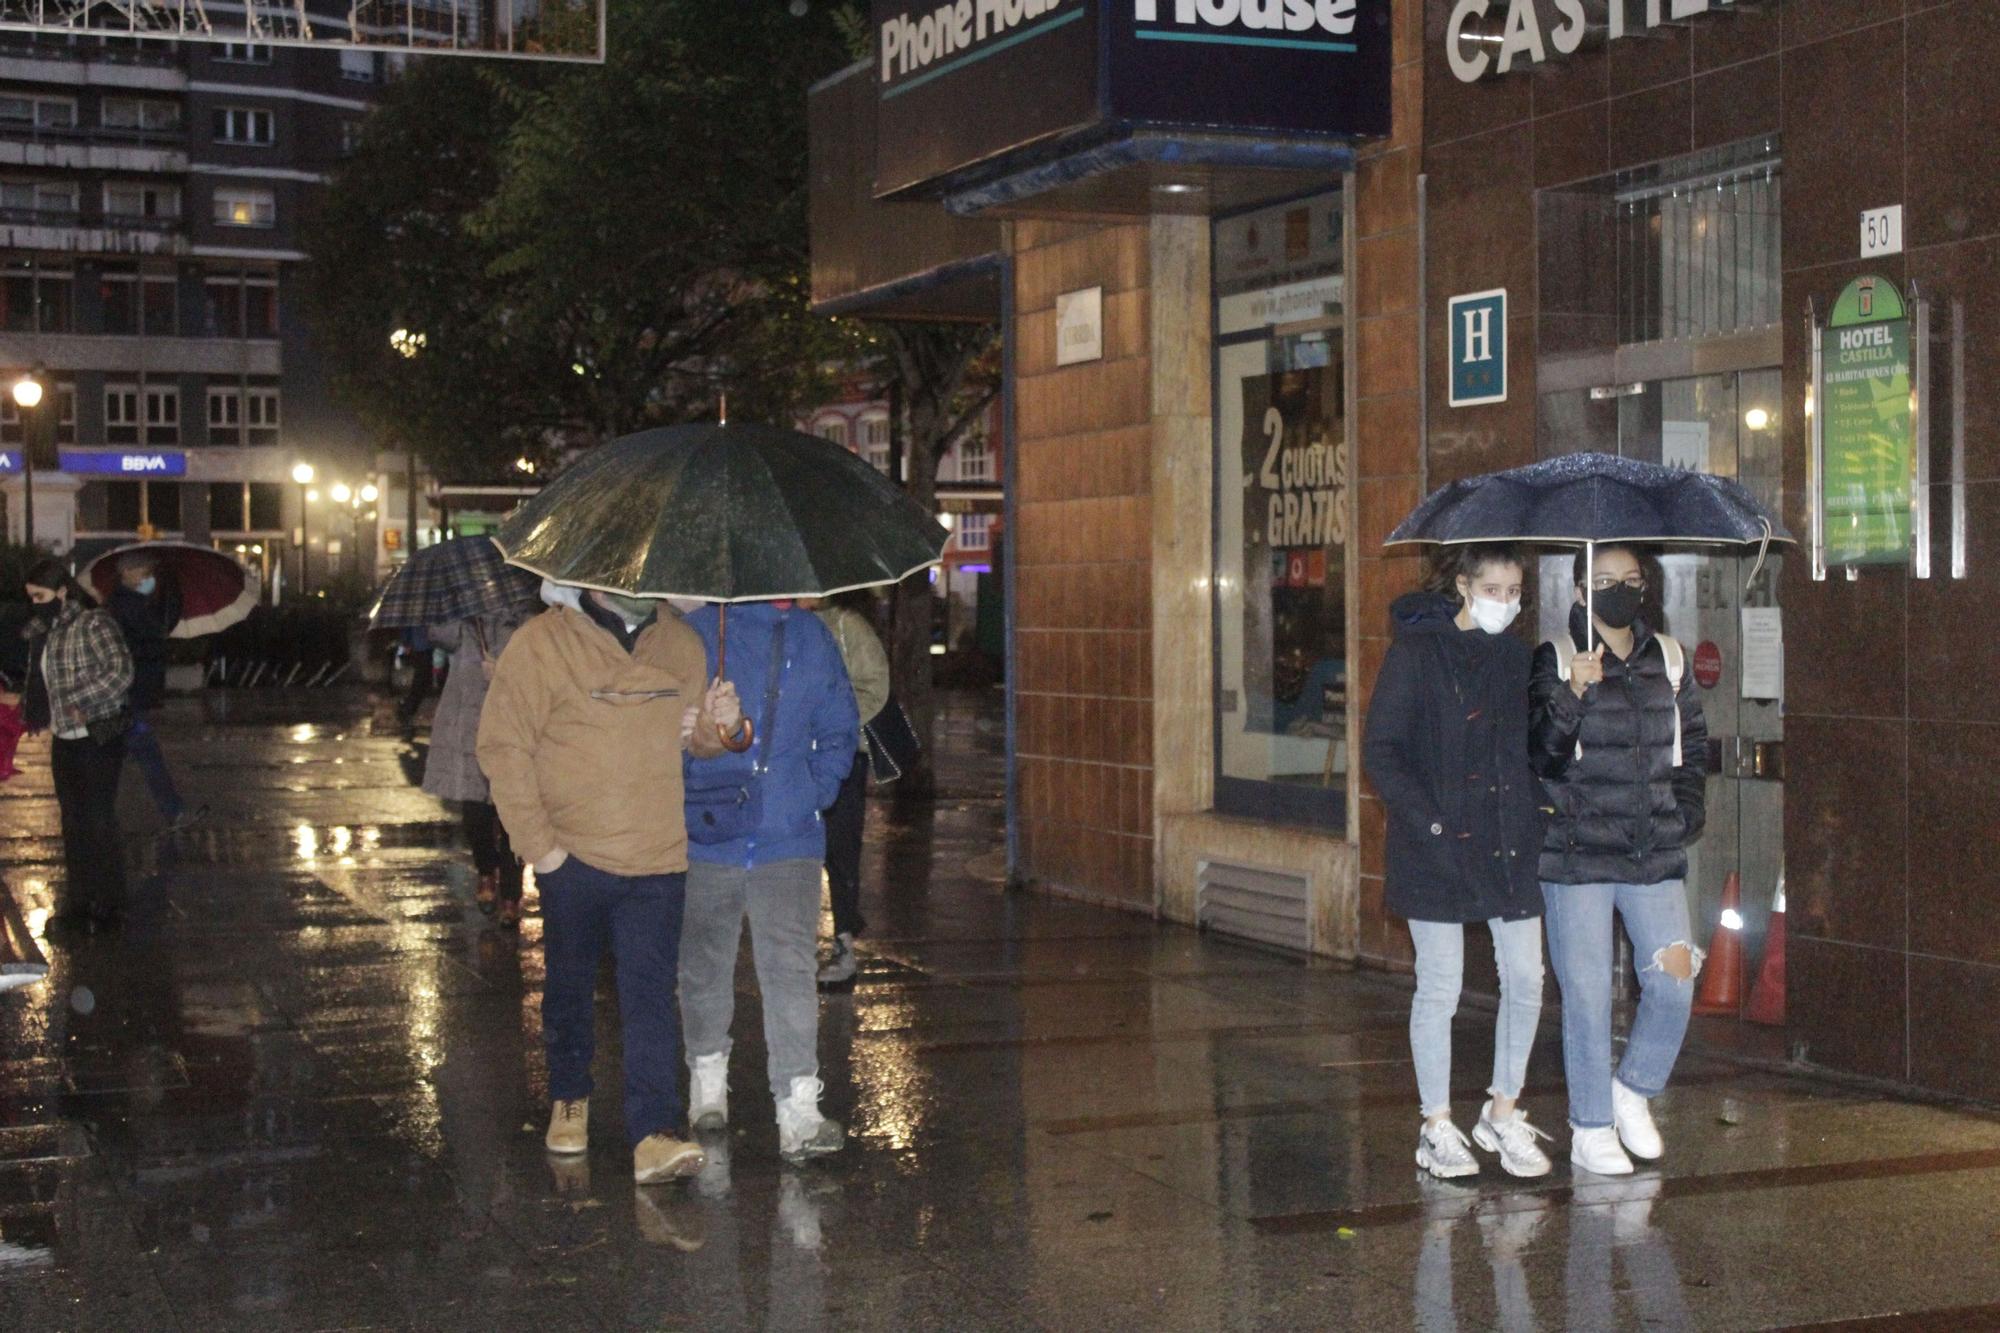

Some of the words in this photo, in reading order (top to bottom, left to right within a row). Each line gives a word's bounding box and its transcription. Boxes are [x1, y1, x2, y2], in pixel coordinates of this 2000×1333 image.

[881, 0, 974, 83] Phone
[1868, 215, 1889, 248] 50
[1462, 307, 1493, 364] H
[1840, 326, 1893, 349] HOTEL
[1840, 346, 1893, 364] CASTILLA
[121, 455, 167, 472] BBVA
[1260, 407, 1283, 489] 2
[1281, 443, 1345, 488] CUOTAS
[1267, 489, 1345, 547] GRATIS
